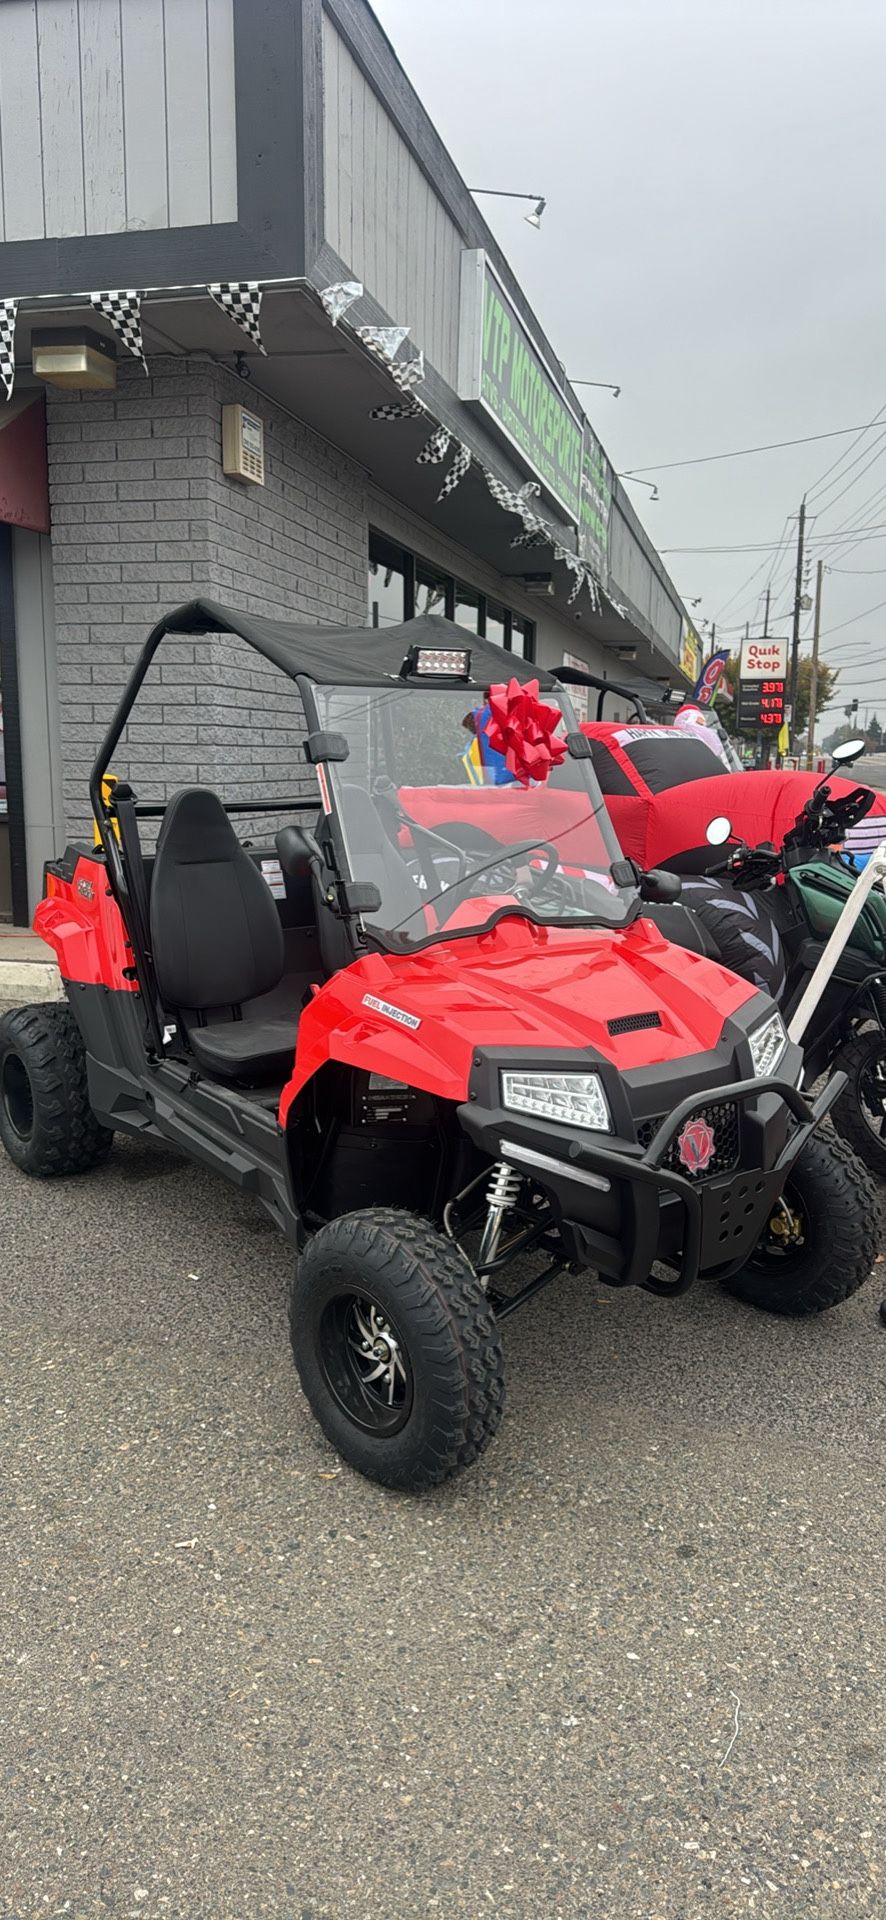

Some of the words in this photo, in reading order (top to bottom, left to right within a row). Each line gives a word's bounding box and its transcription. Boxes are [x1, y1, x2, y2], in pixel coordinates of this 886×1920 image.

[511, 331, 581, 488] MOTORSPORTS
[748, 645, 780, 659] Quik
[747, 659, 780, 673] Stop
[363, 995, 381, 1010] FUEL
[381, 1003, 419, 1028] INJECTION
